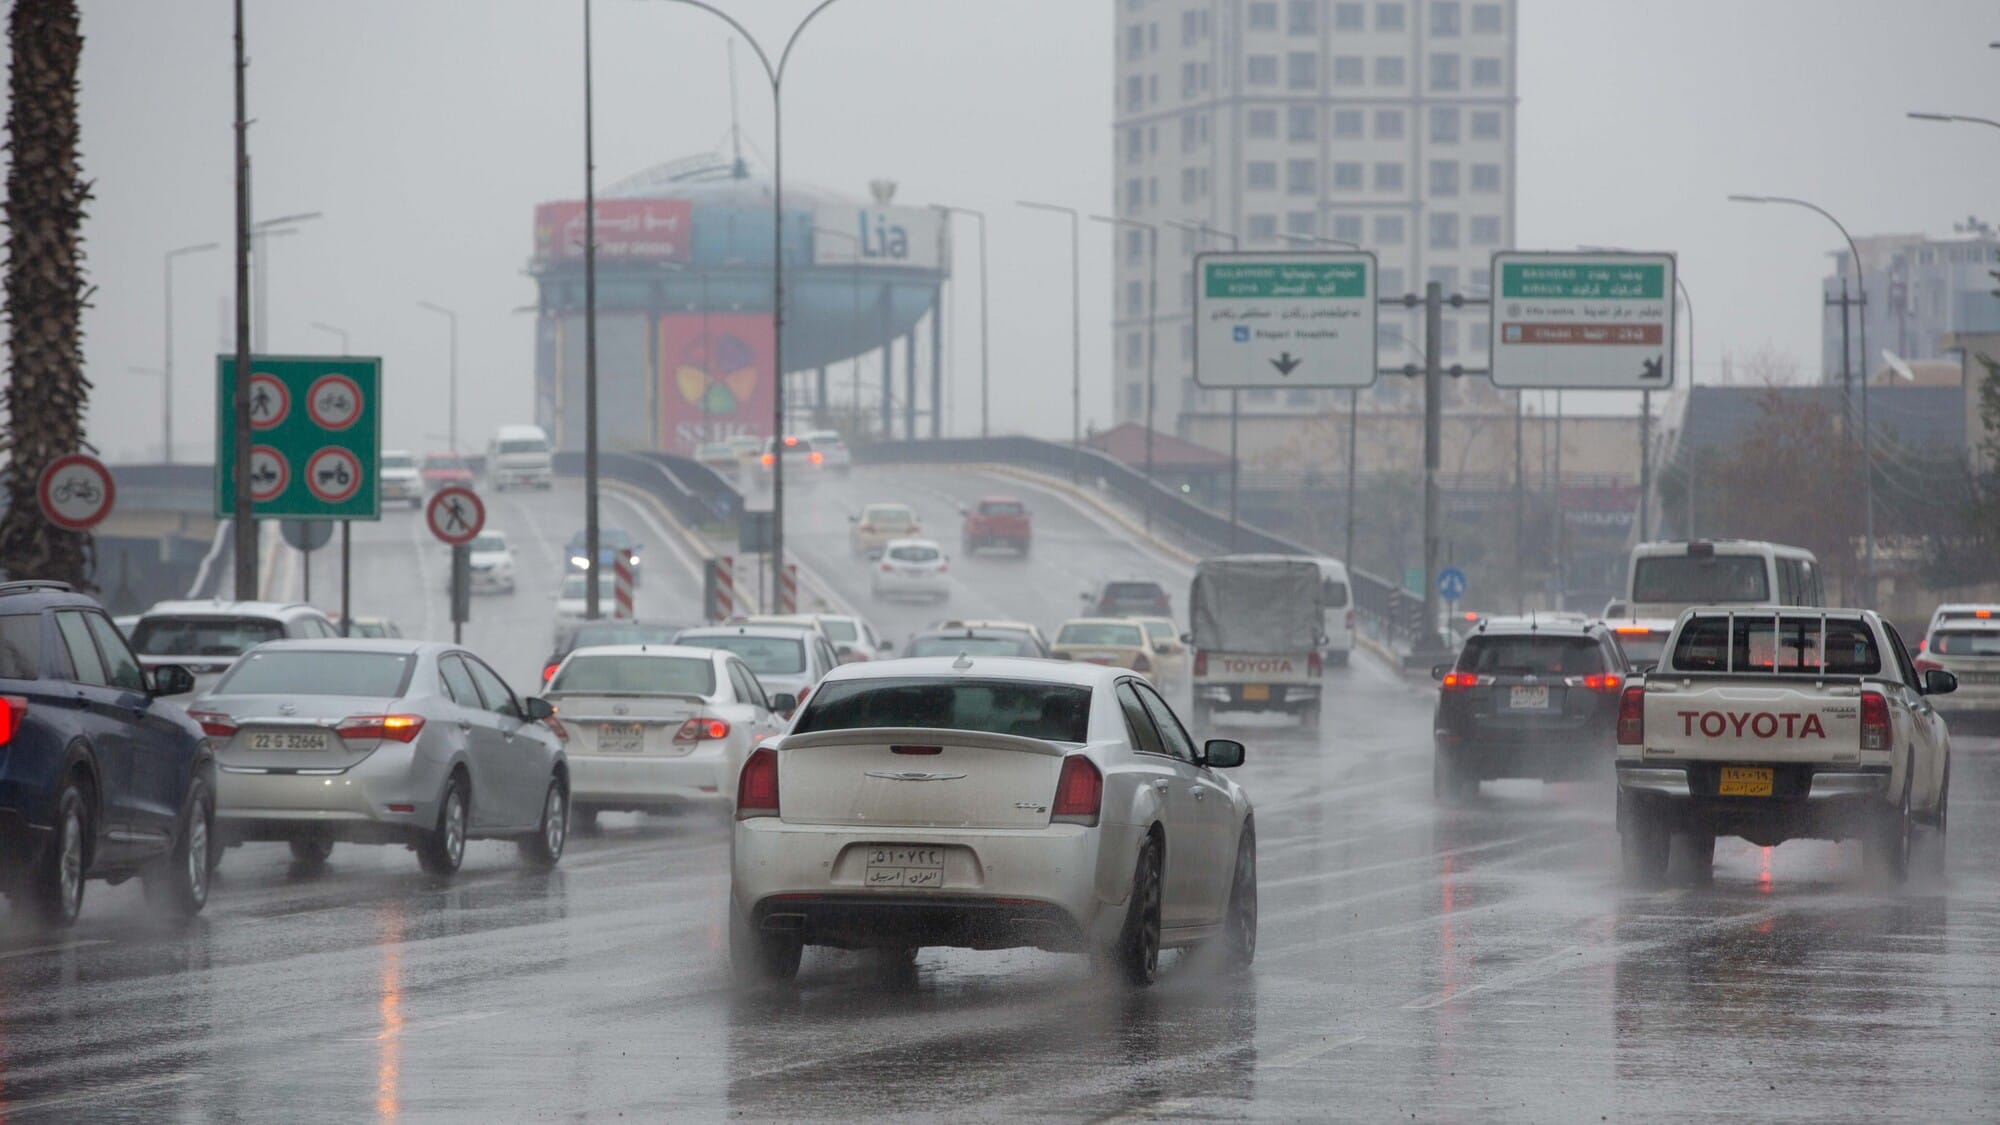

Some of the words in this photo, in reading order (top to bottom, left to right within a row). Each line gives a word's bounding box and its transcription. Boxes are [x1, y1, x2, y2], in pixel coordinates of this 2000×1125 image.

[859, 209, 908, 258] Lia
[1224, 659, 1292, 673] TOYOTA
[1677, 711, 1826, 738] TOYOTA
